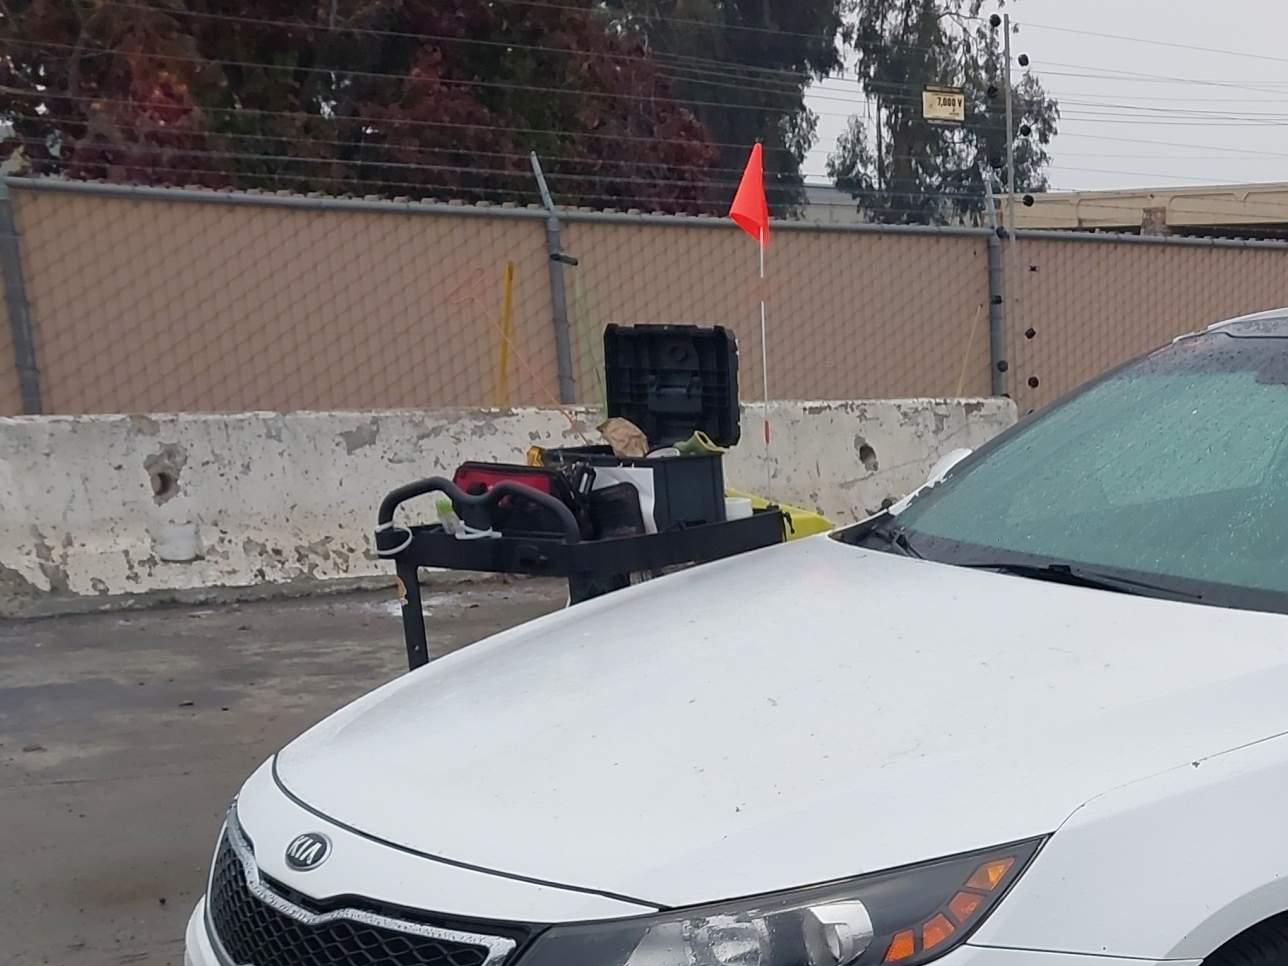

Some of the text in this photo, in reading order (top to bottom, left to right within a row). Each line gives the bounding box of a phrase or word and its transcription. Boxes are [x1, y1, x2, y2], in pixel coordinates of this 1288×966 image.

[936, 97, 963, 108] 7,000 V
[287, 835, 322, 865] KIA
